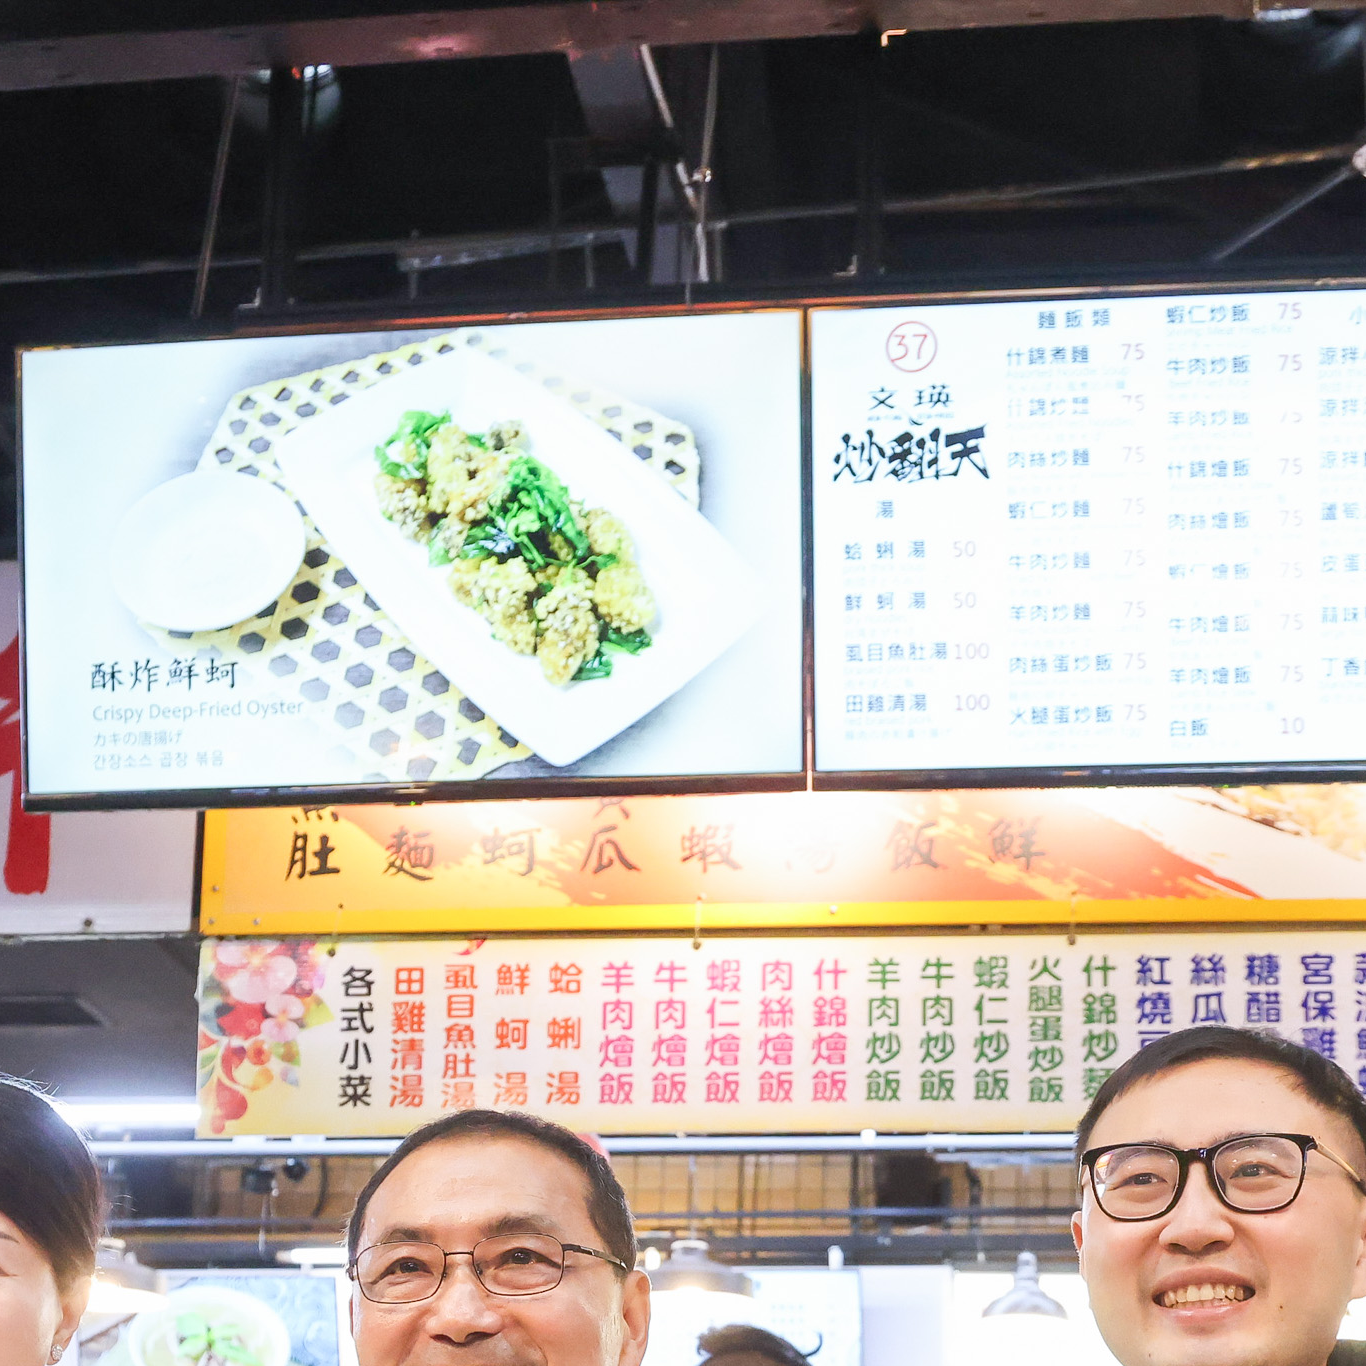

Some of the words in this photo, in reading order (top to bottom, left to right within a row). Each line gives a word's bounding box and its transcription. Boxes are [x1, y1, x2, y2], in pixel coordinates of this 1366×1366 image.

[891, 333, 927, 361] 37
[91, 657, 239, 693] 酥炸鮮蚵
[93, 704, 144, 724] Crispy
[149, 701, 242, 722] Deep-Fried
[247, 700, 305, 719] Oyster
[338, 966, 375, 1109] 各式小菜
[389, 967, 425, 1108] 田雞清湯
[441, 964, 478, 1111] 虱目魚肚湯
[493, 963, 531, 1107] 鮮蚵湯
[546, 962, 582, 1106] 蛤蜊湯
[598, 960, 635, 1105] 羊肉燴飯
[652, 961, 688, 1104] 牛肉燴飯
[705, 960, 740, 1104] 蝦仁燴飯
[757, 960, 793, 1103] 肉絲燴飯
[811, 958, 848, 1103] 什錦燴飯
[865, 957, 901, 1103] 羊肉炒飯
[919, 956, 955, 1102] 牛肉炒飯
[973, 955, 1009, 1102] 蝦仁炒飯
[1027, 956, 1064, 1103] 火腿蛋炒飯
